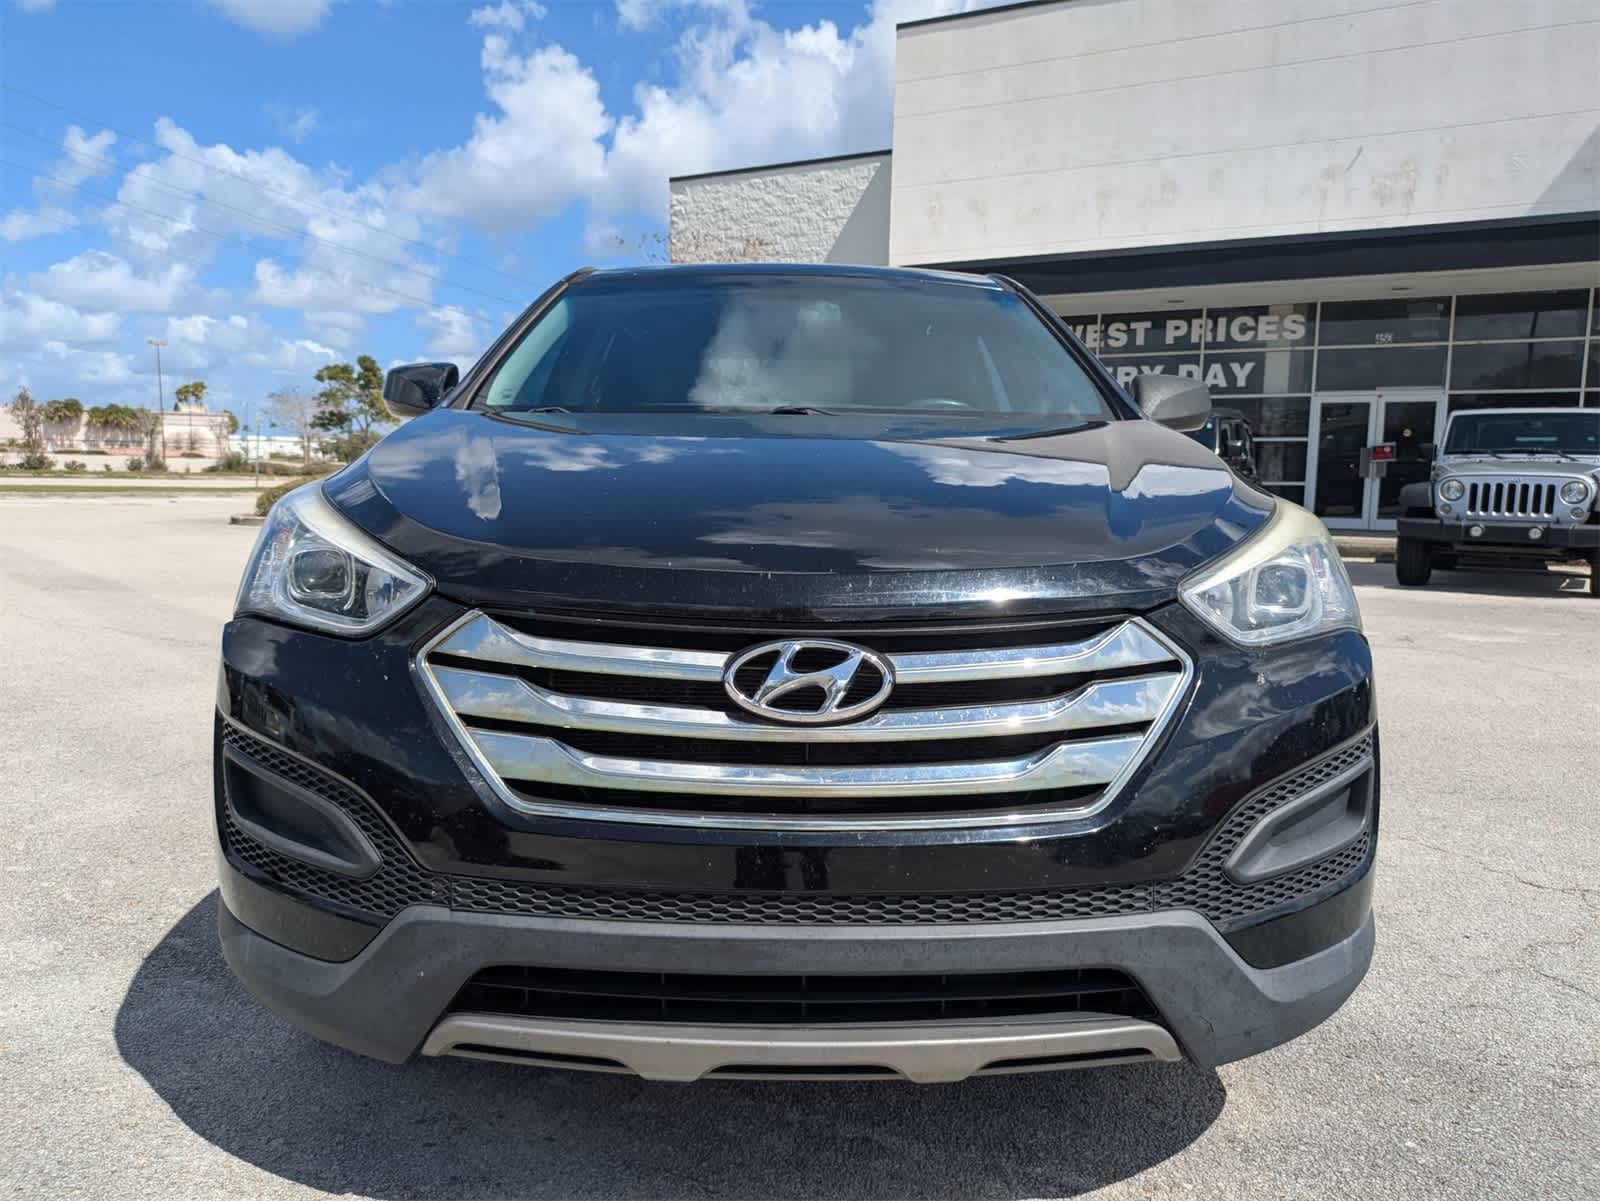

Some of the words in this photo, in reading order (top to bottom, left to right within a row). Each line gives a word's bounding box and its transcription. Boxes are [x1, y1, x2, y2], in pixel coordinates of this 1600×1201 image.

[1072, 321, 1152, 348] EST
[1165, 314, 1306, 345] PRICES
[1178, 362, 1256, 388] DAY
